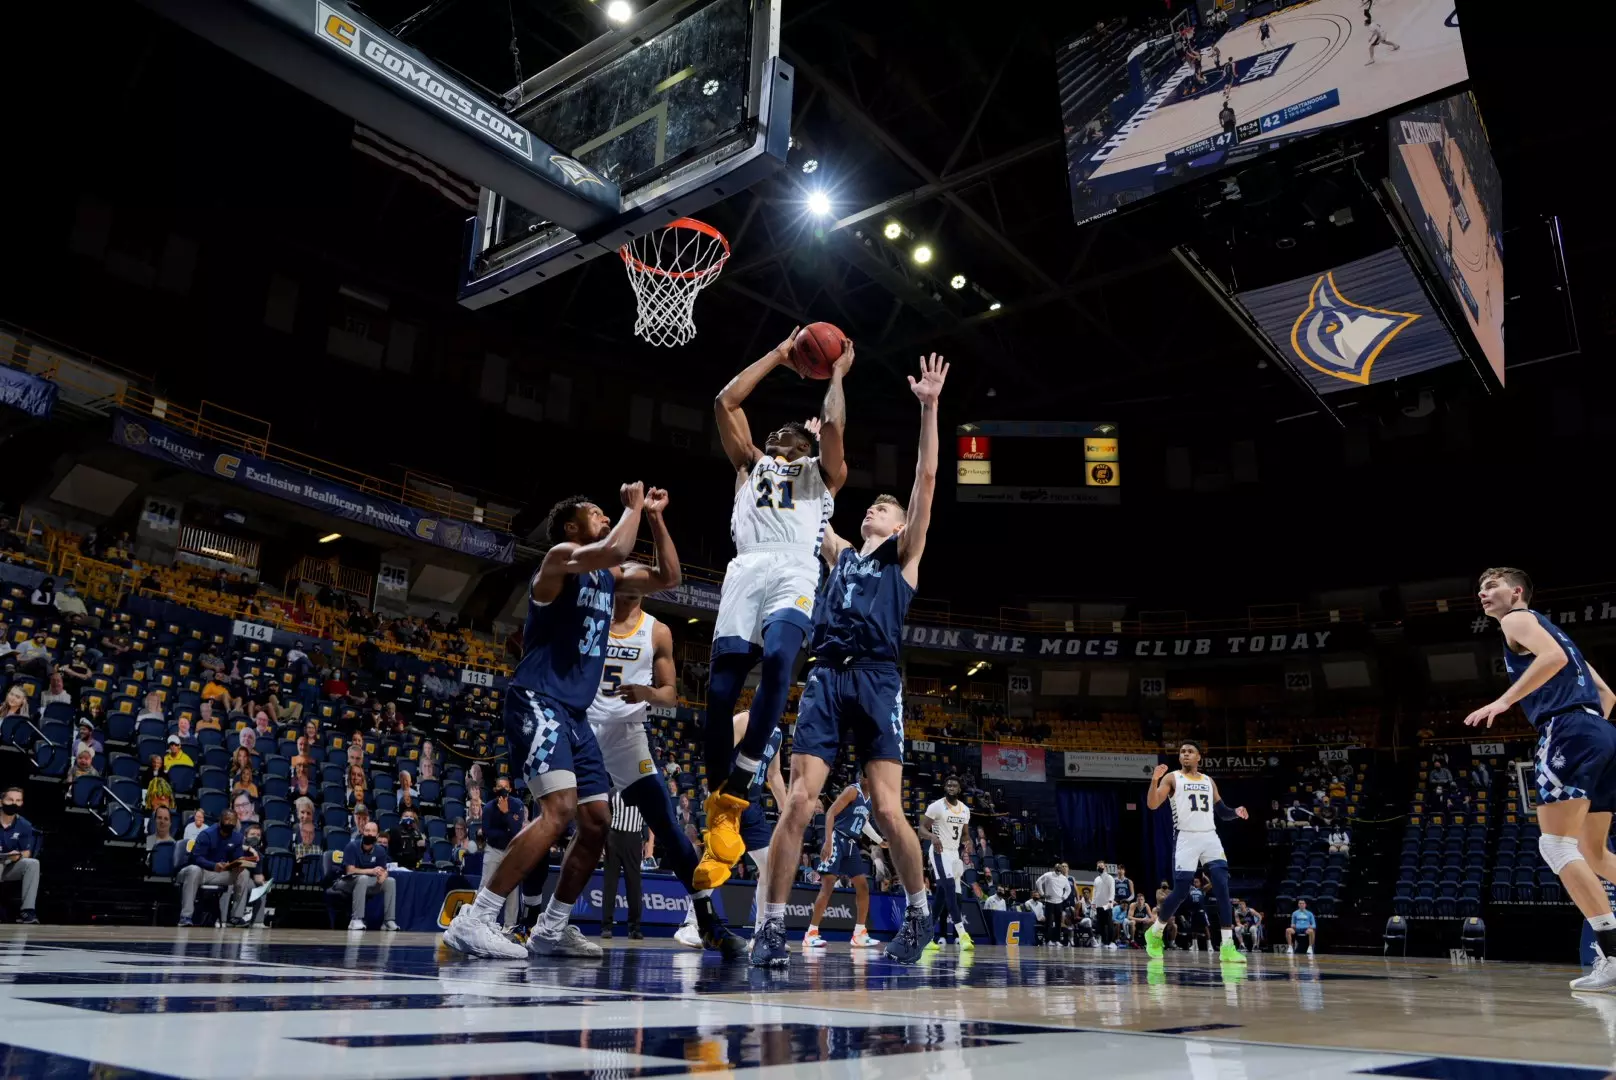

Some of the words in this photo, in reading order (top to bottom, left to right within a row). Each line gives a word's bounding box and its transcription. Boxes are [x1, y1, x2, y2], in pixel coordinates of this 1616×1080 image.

[1263, 114, 1281, 127] 42
[1216, 132, 1232, 145] 47
[149, 436, 205, 460] erlanger
[245, 466, 301, 495] Exclusive
[303, 485, 364, 515] Healthcare
[366, 505, 411, 529] Provider
[756, 477, 795, 509] 21
[242, 624, 265, 639] 114
[973, 632, 1027, 653] THE
[1039, 638, 1119, 656] MOCS
[1135, 638, 1212, 657] CLUB
[1228, 630, 1332, 654] TODAY
[606, 646, 641, 660] OCS
[468, 672, 487, 685] 115
[917, 742, 931, 751] 117
[1477, 744, 1499, 754] 121
[1325, 750, 1343, 760] 120
[1198, 756, 1223, 768] UBY
[1226, 756, 1267, 768] FALLS
[1188, 793, 1210, 812] 13
[952, 825, 960, 840] 3
